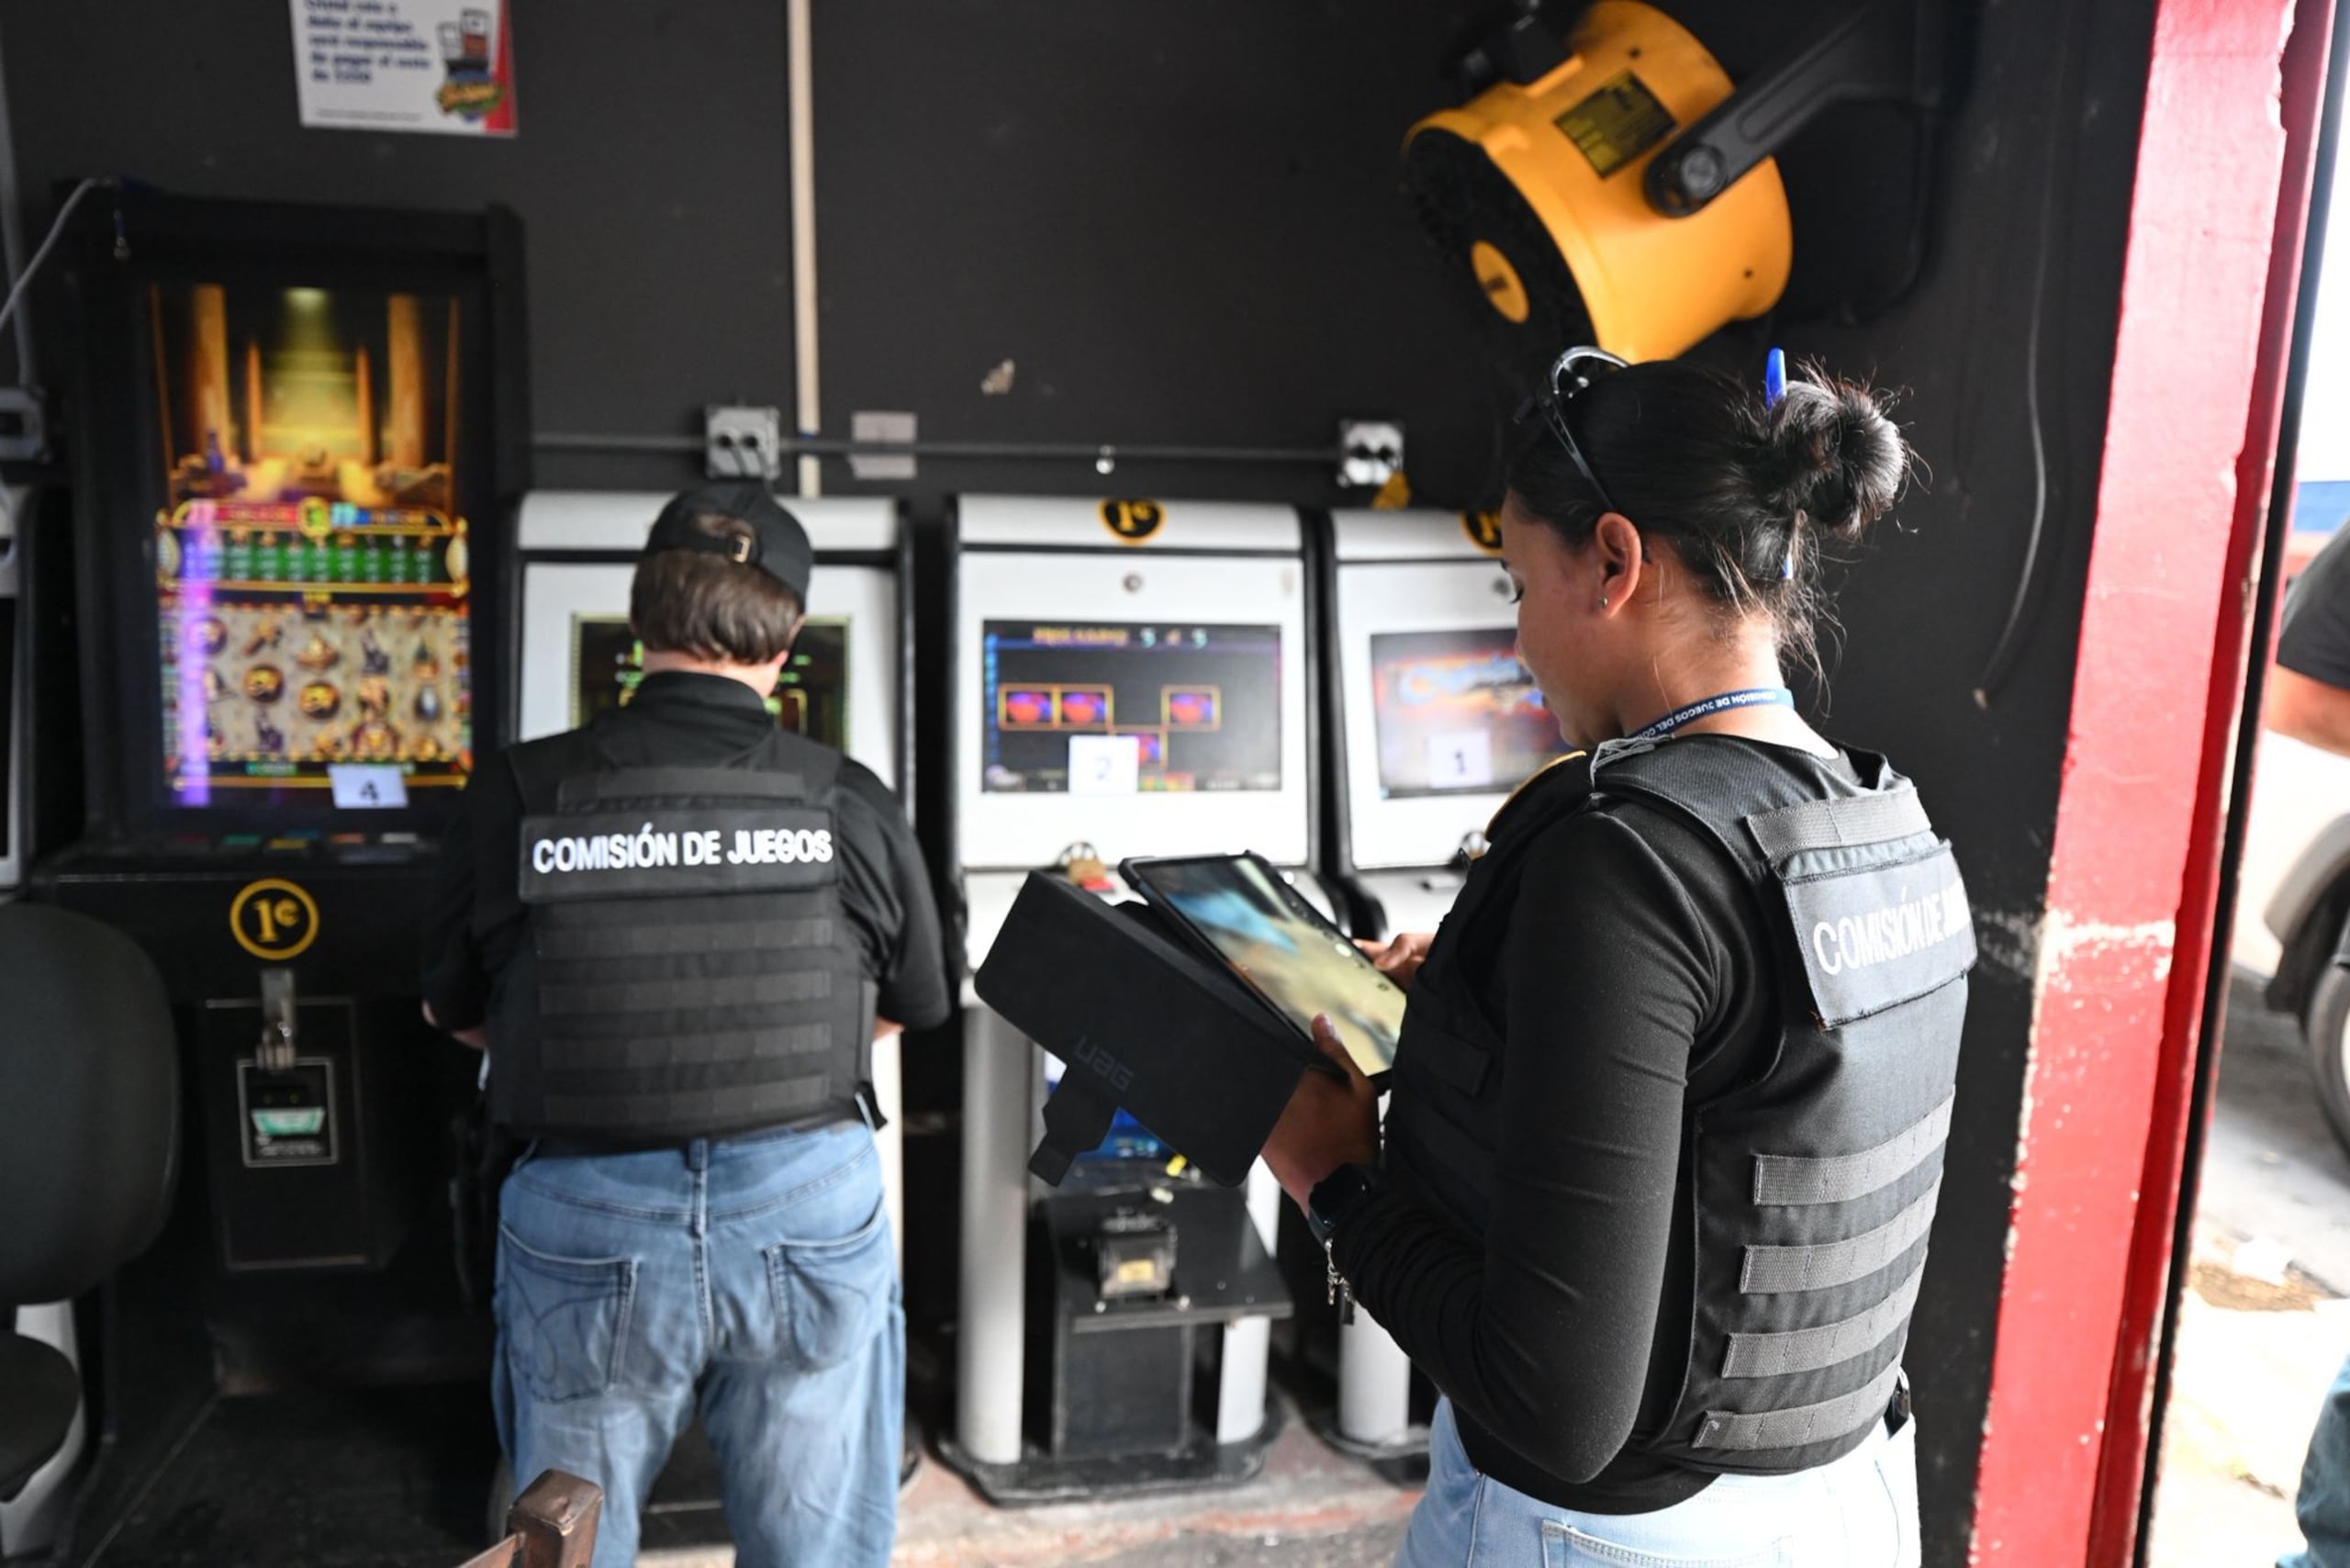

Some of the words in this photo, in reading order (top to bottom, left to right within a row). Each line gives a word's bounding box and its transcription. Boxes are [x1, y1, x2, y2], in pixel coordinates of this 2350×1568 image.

[1658, 718, 1674, 733] DEL
[532, 822, 677, 873] COMISIÓN
[683, 830, 722, 866] DE
[727, 829, 834, 865] JUEGOS
[1813, 884, 1928, 975] COMISIÓN
